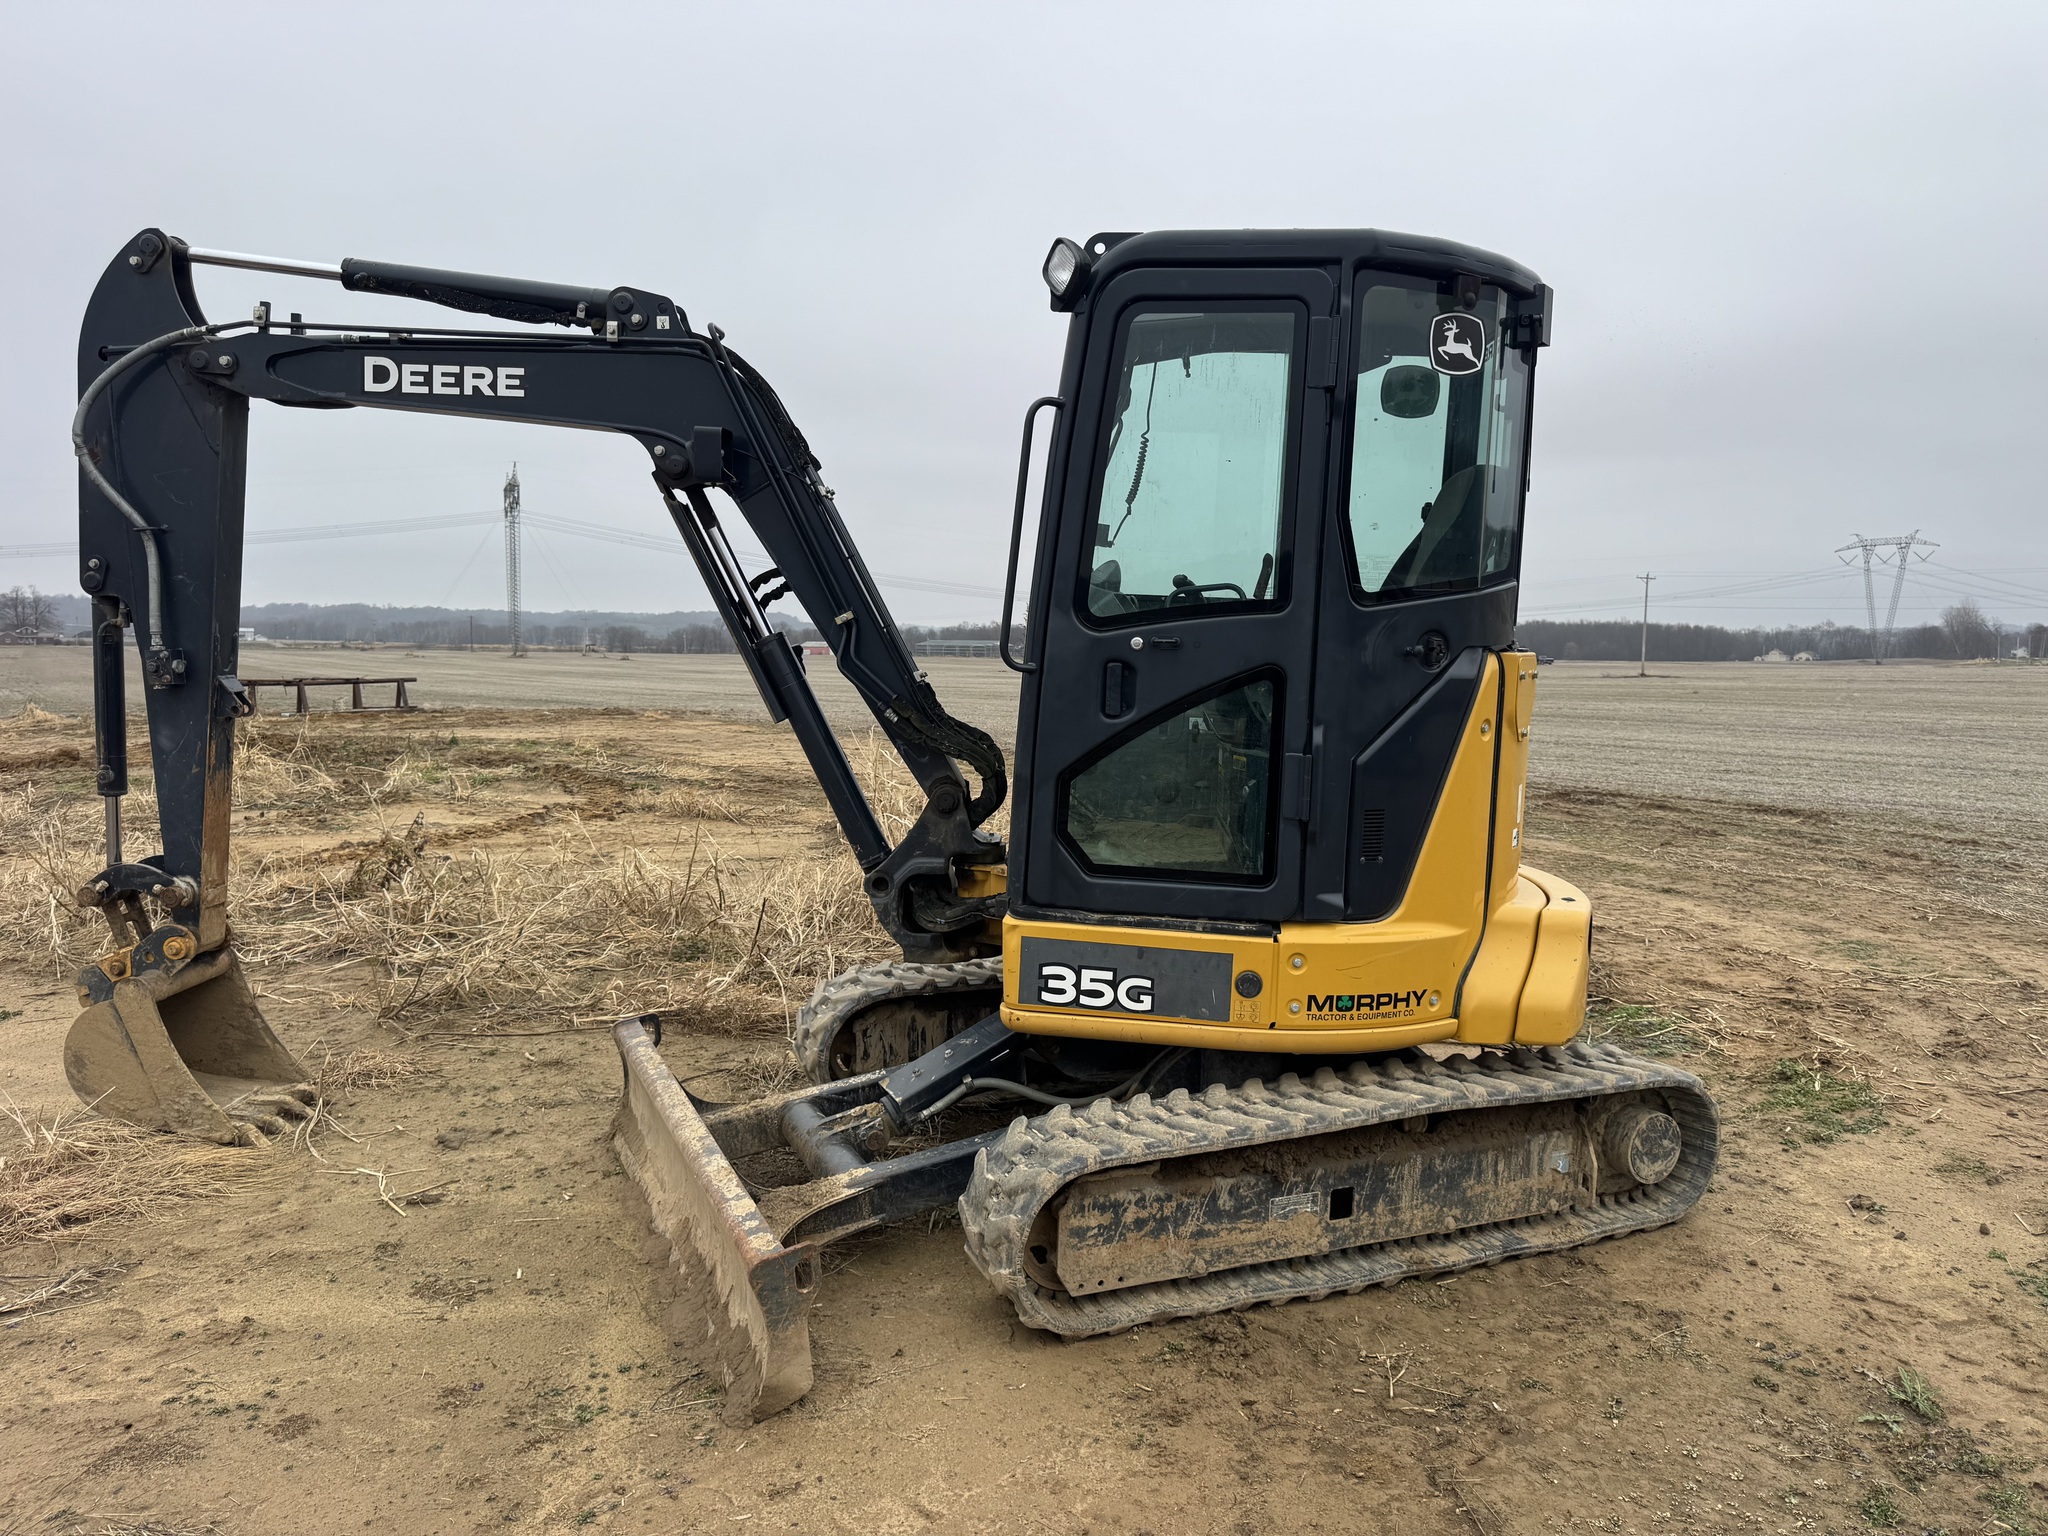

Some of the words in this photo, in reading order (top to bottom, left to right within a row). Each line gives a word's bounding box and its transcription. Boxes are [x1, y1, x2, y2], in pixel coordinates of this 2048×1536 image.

[364, 356, 525, 397] DEERE
[1039, 964, 1153, 1012] 35G
[1306, 989, 1428, 1012] MURPHY
[1306, 1013, 1347, 1021] TRACTOR
[1357, 1010, 1402, 1020] EQUIPMENT
[1403, 1009, 1416, 1017] CO.
